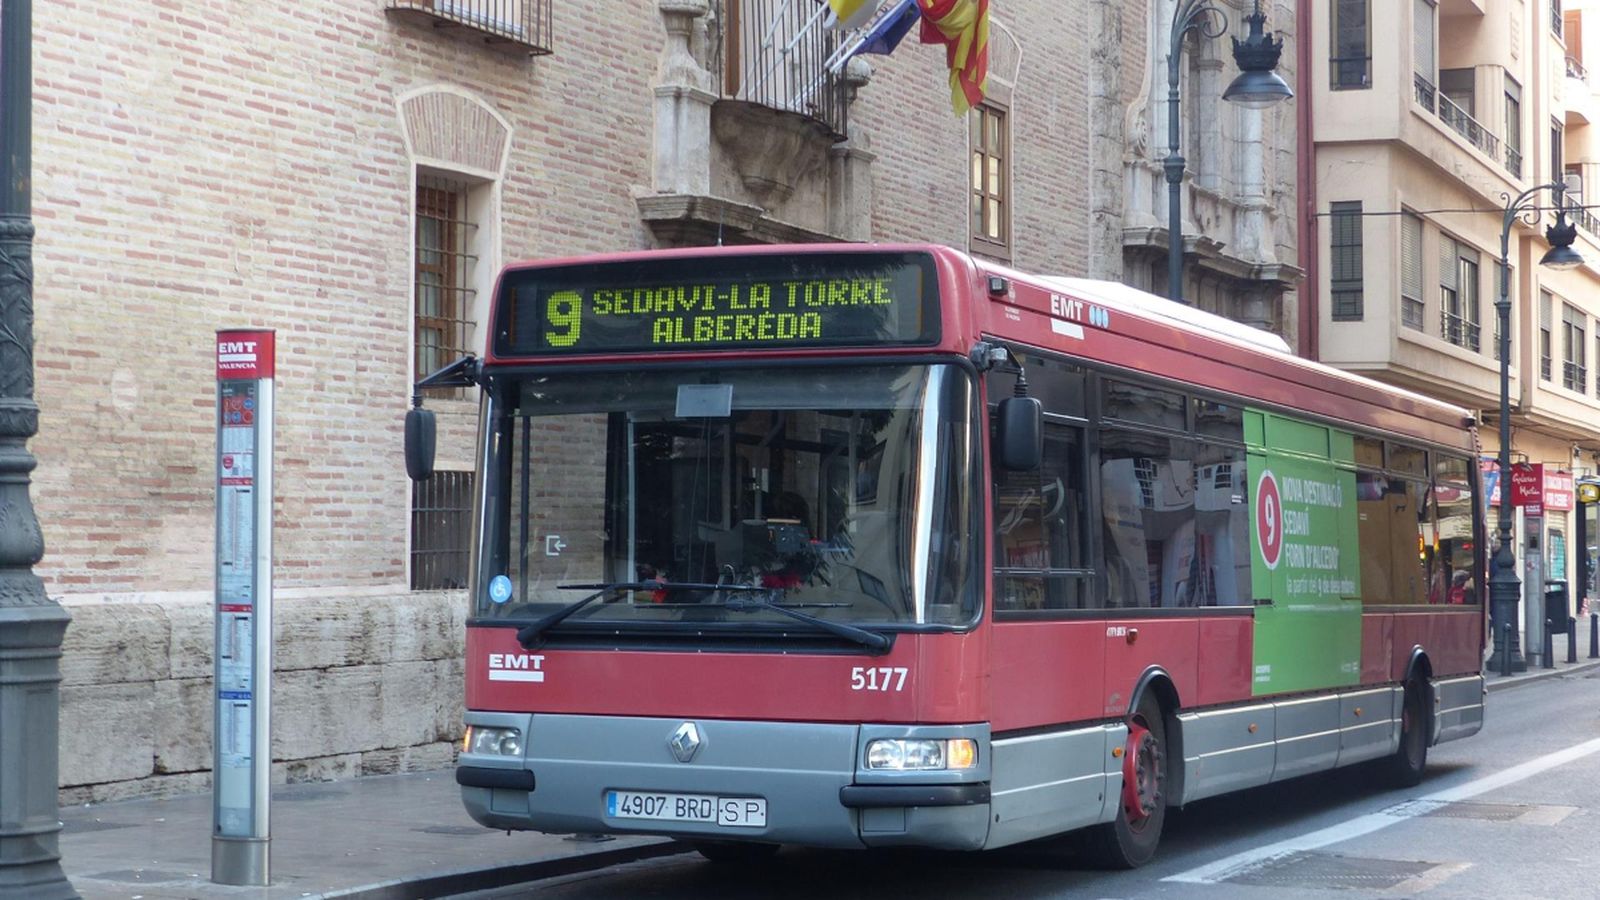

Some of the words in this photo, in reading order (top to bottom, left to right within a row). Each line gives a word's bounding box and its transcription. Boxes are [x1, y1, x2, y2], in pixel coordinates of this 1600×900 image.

[592, 283, 770, 315] SEDAVI-LA
[783, 278, 892, 308] TORRE
[1050, 293, 1083, 321] EMT
[546, 290, 582, 347] 9
[218, 341, 257, 353] EMT
[218, 362, 257, 370] VALENCIA
[1282, 476, 1304, 503] NOVA
[1265, 494, 1275, 546] 9
[1283, 506, 1310, 535] SEDAVÍ
[1285, 543, 1305, 568] FORN
[488, 653, 545, 669] EMT
[851, 666, 909, 691] 5177
[620, 794, 667, 816] 4907
[675, 797, 712, 819] BRD
